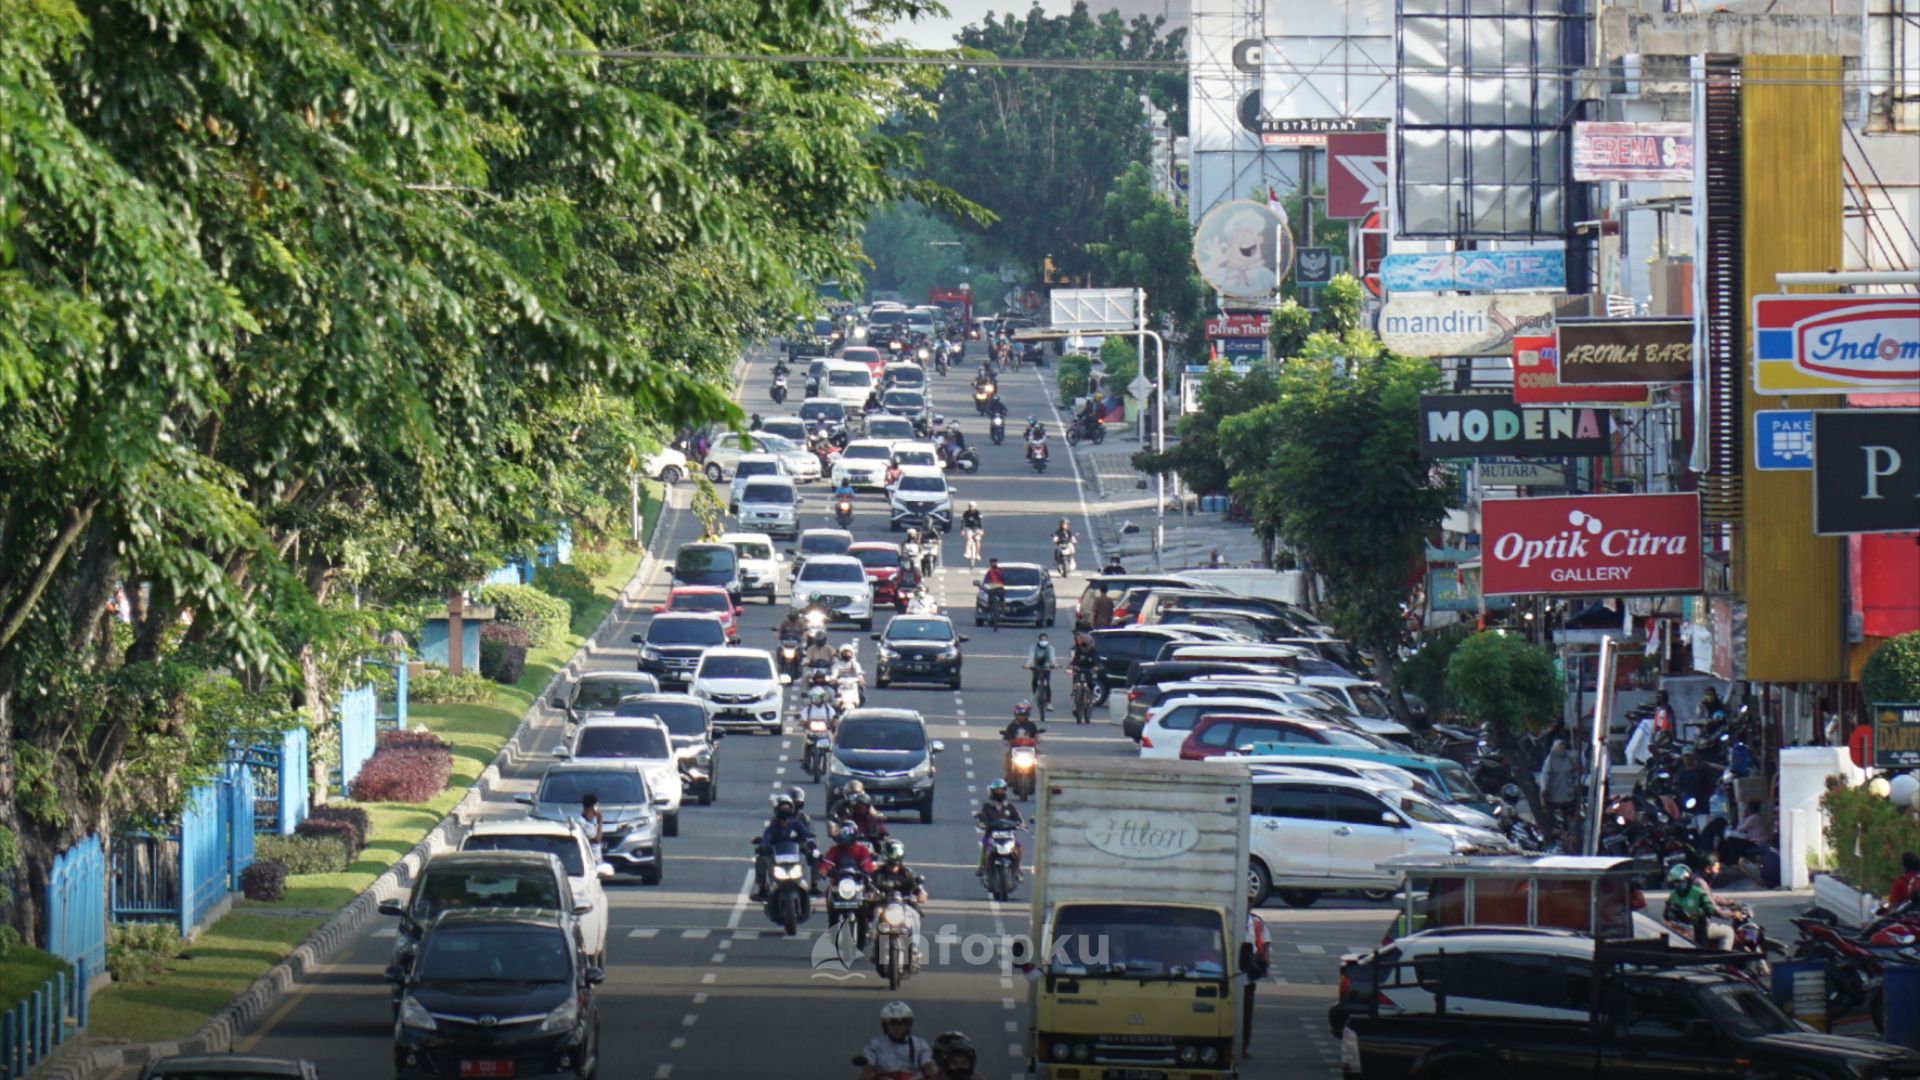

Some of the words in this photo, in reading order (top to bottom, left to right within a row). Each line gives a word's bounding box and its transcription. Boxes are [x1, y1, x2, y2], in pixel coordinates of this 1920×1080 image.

[1262, 120, 1357, 131] RESTAURANT
[1208, 322, 1240, 335] Drive
[1241, 322, 1269, 335] Thru
[1385, 310, 1484, 334] mandiri
[1564, 344, 1639, 365] AROMA
[1427, 407, 1601, 443] MODENA
[1480, 464, 1538, 478] MUTIARA
[1493, 530, 1590, 568] Optik
[1600, 528, 1688, 557] Citra
[1550, 566, 1633, 582] GALLERY
